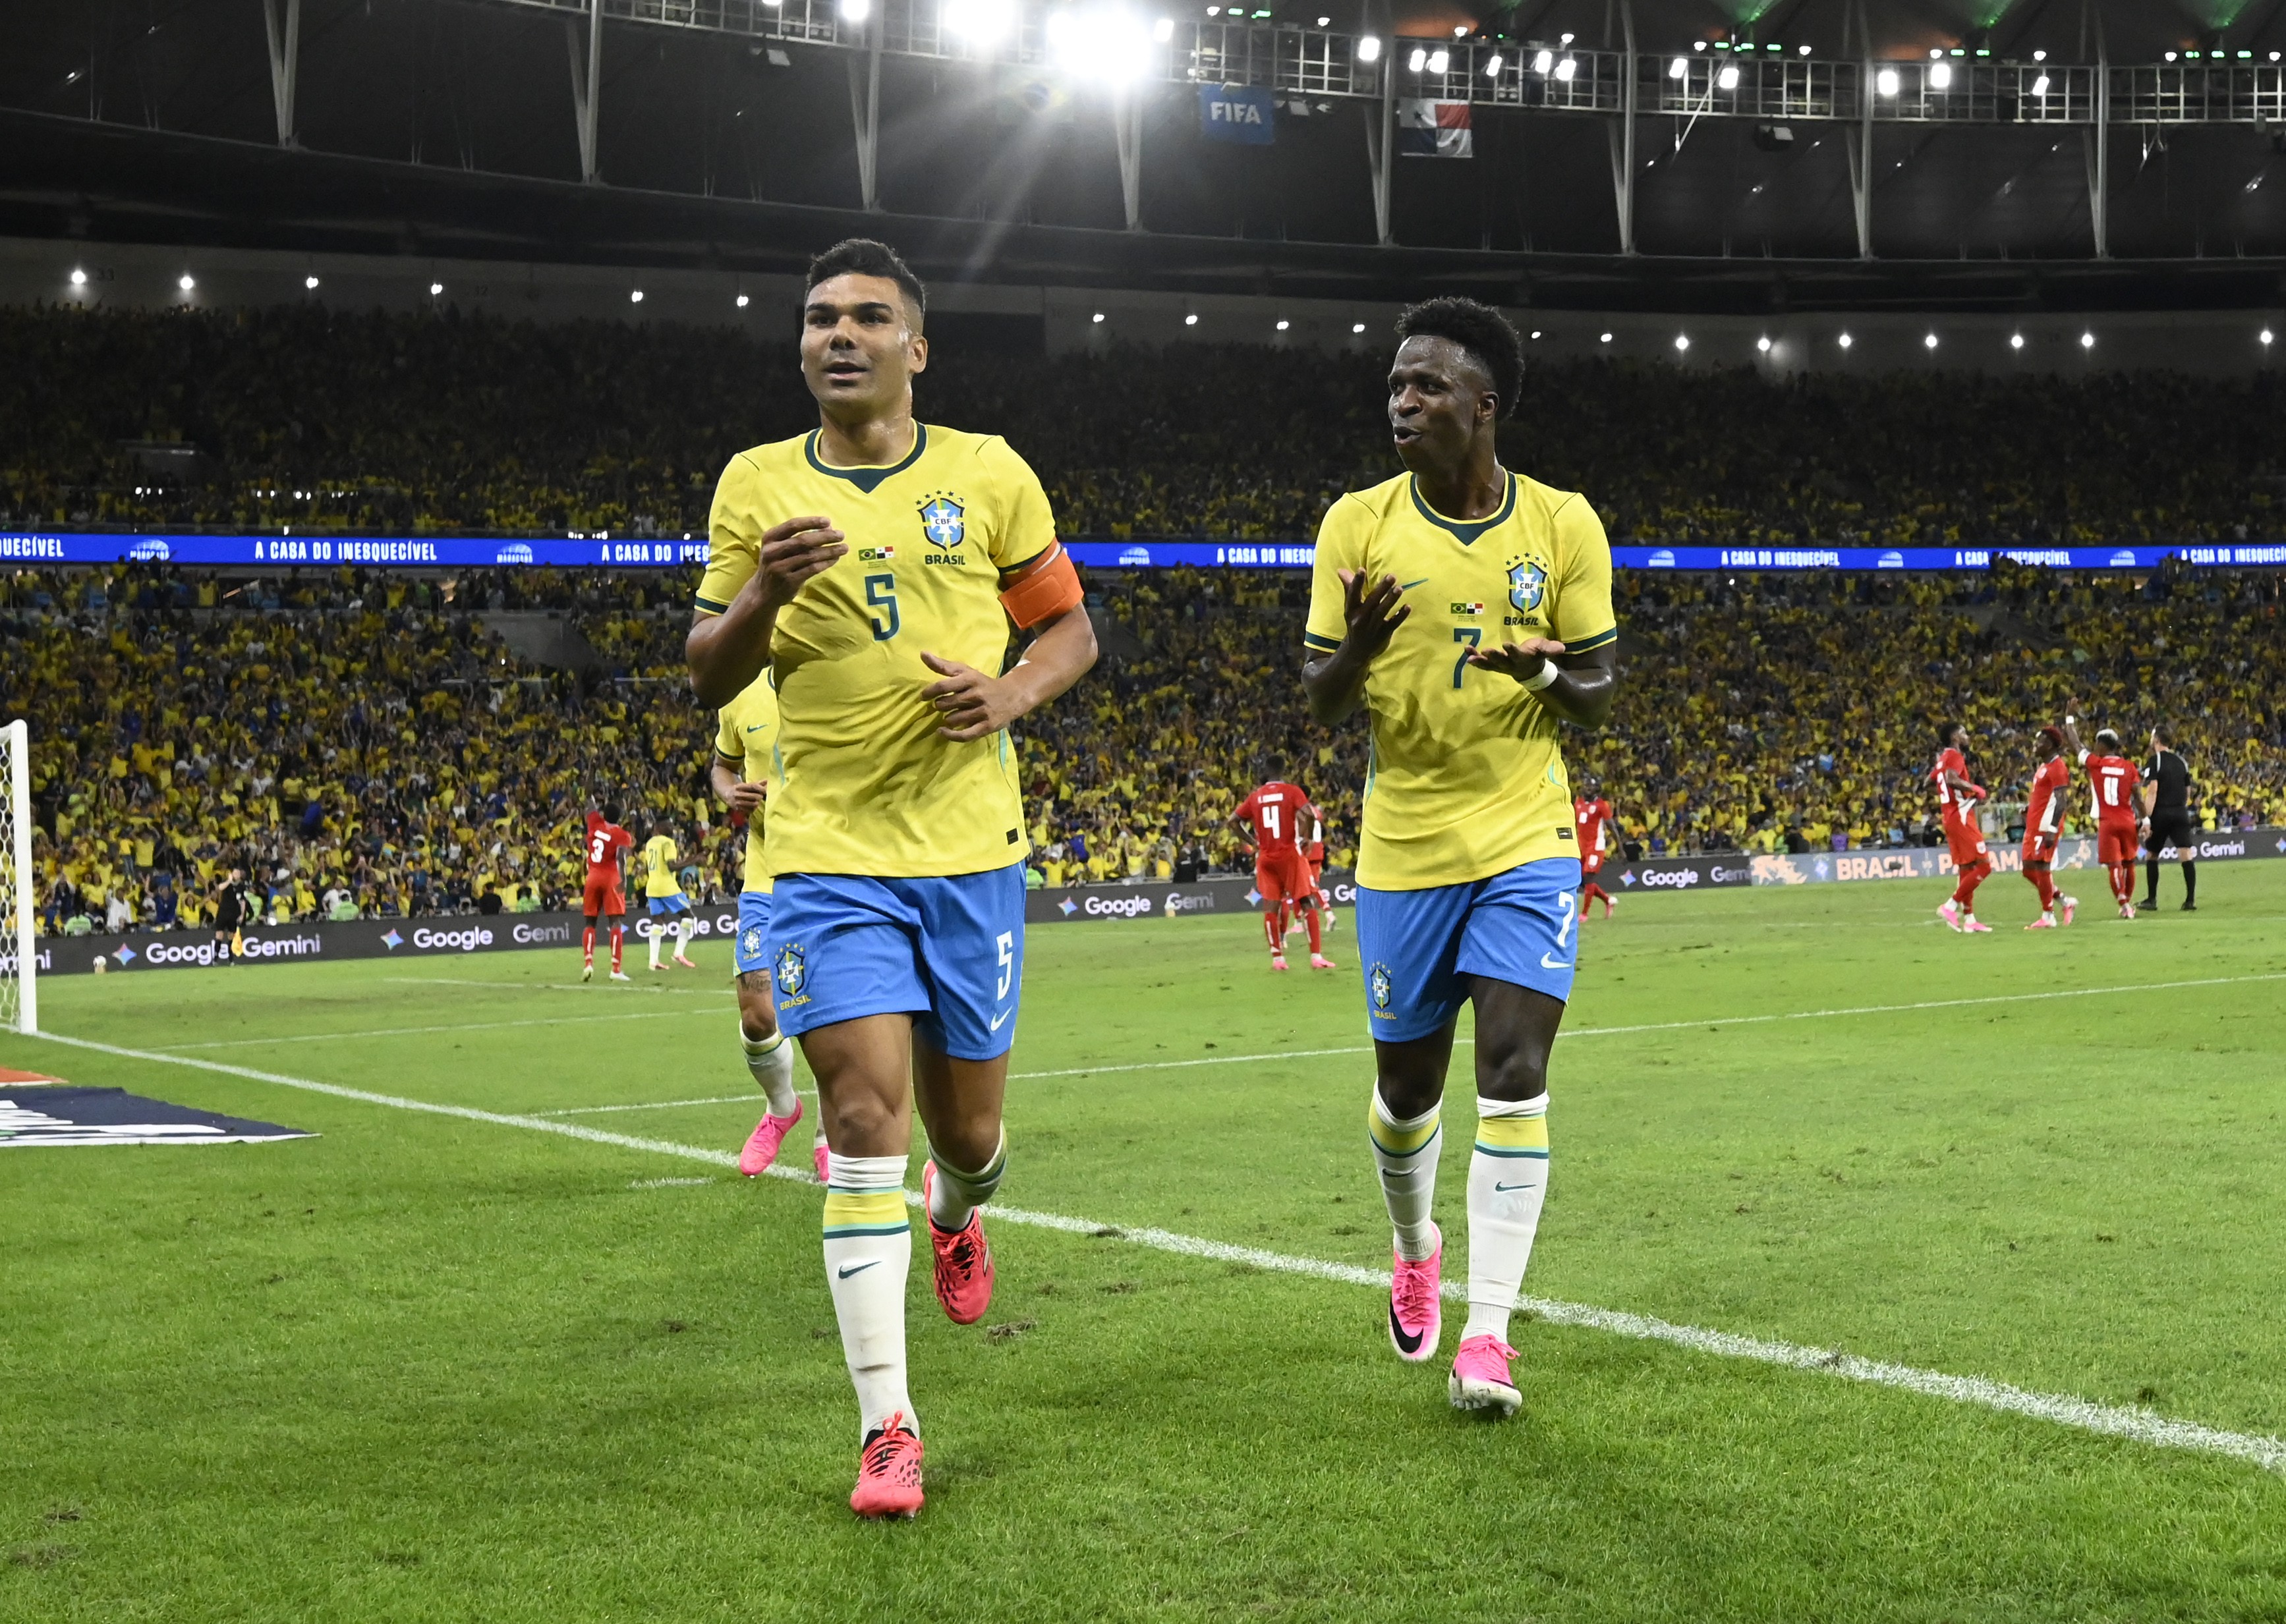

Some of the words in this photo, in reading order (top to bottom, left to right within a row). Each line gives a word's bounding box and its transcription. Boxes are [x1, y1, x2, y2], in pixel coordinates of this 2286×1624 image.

[1210, 102, 1262, 125] FIFA
[0, 536, 64, 557] UECÍVEL
[255, 541, 264, 559] A
[270, 542, 306, 560] CASA
[312, 542, 331, 560] DO
[338, 540, 437, 562] INESQUECÍVEL
[602, 544, 610, 561] A
[615, 544, 649, 561] CASA
[654, 545, 672, 561] DO
[1217, 547, 1225, 563] A
[1228, 547, 1257, 563] CASA
[1261, 548, 1276, 563] DO
[2190, 549, 2215, 563] CASA
[2217, 548, 2231, 563] DO
[2235, 546, 2286, 563] INESQUECÍ
[925, 555, 966, 565] BRASIL
[1721, 551, 1729, 565] A
[1730, 551, 1756, 565] CASA
[1758, 551, 1772, 566] DO
[1956, 551, 1962, 565] A
[1964, 551, 1989, 565] CASA
[865, 573, 900, 641] 5
[1504, 616, 1539, 626] BRASIL
[1454, 628, 1481, 688] 7
[1262, 805, 1280, 839] 4
[591, 839, 604, 863] 3
[2200, 839, 2245, 857] Gemini
[648, 848, 658, 871] 21
[1837, 855, 1918, 880] BRASIL
[1642, 868, 1698, 888] Google
[1085, 895, 1151, 917] Google
[1557, 891, 1574, 947] 7
[242, 933, 321, 957] Gemini
[413, 926, 493, 950] Google
[996, 930, 1014, 1001] 5
[780, 994, 812, 1011] BRASIL
